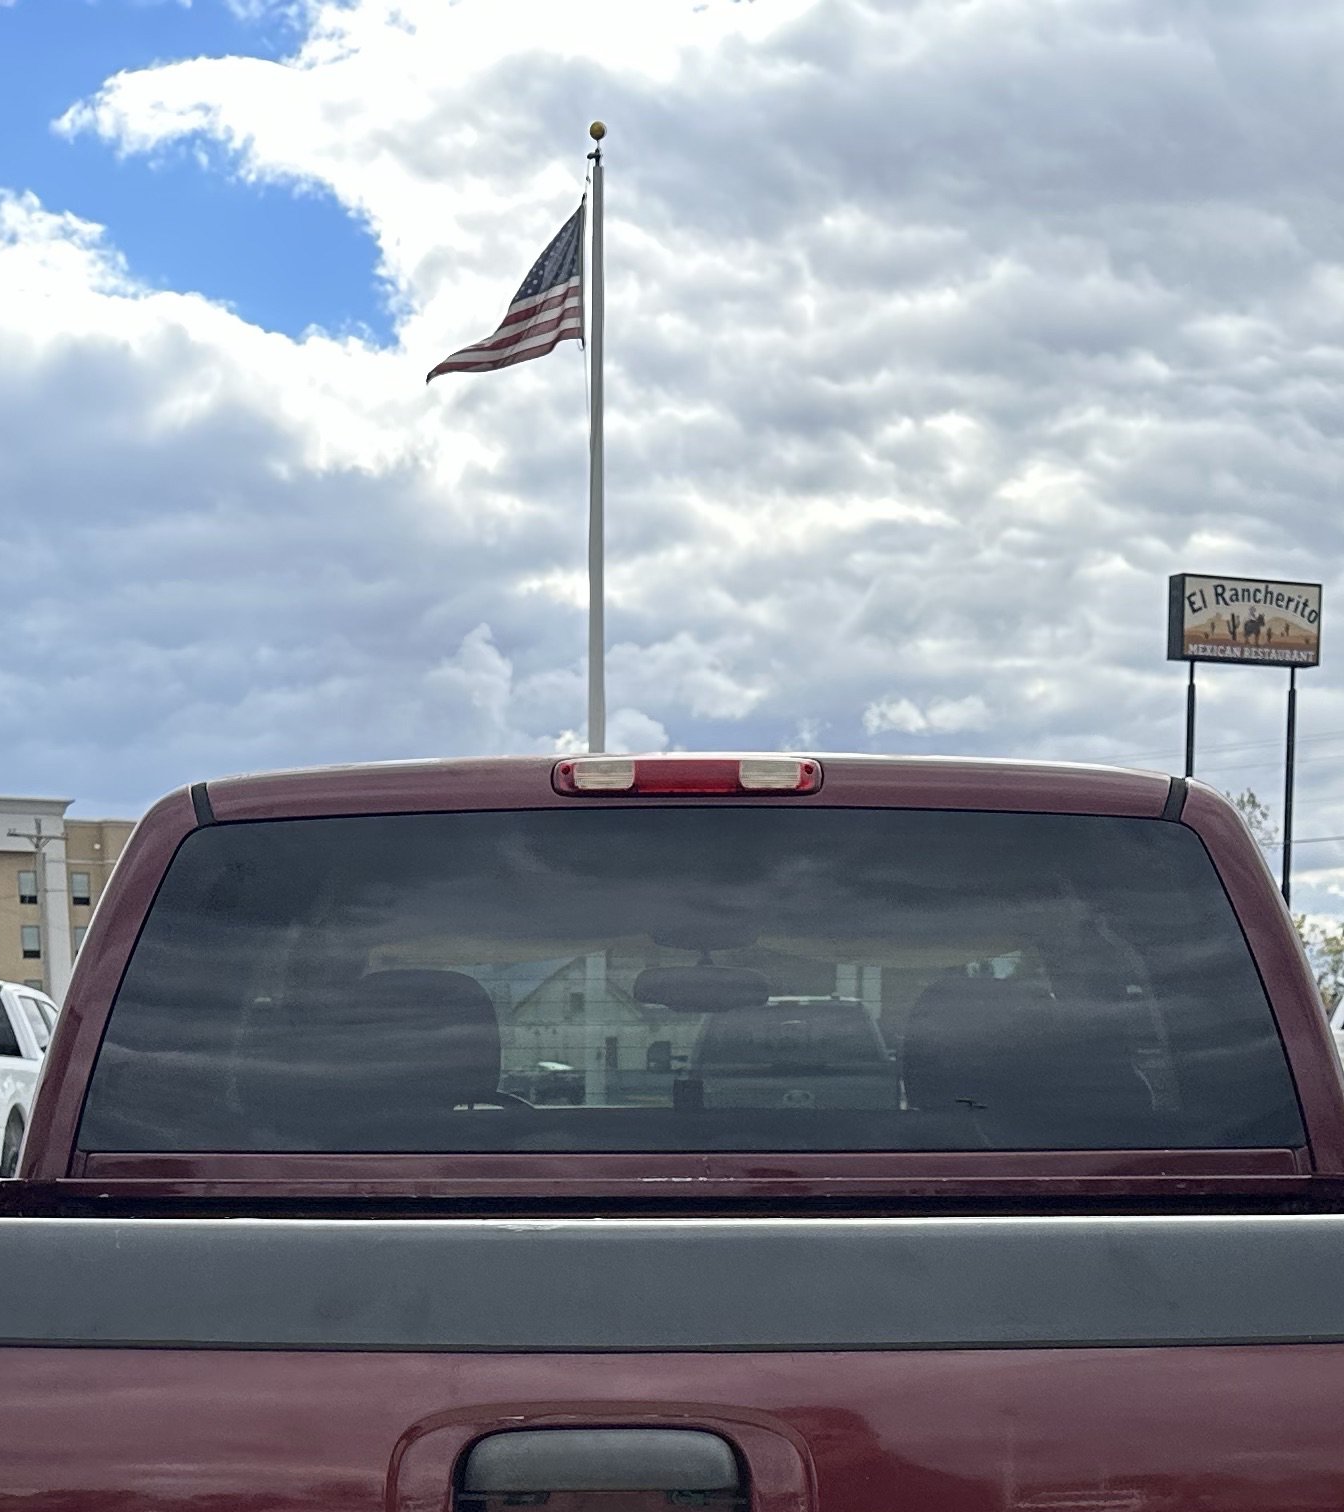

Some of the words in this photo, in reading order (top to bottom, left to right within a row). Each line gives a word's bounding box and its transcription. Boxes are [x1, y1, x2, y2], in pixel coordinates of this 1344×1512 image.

[1186, 590, 1207, 614] El
[1213, 584, 1319, 625] Rancherito
[1188, 643, 1241, 658] MEXICAN
[1244, 648, 1316, 663] RESTAURANT
